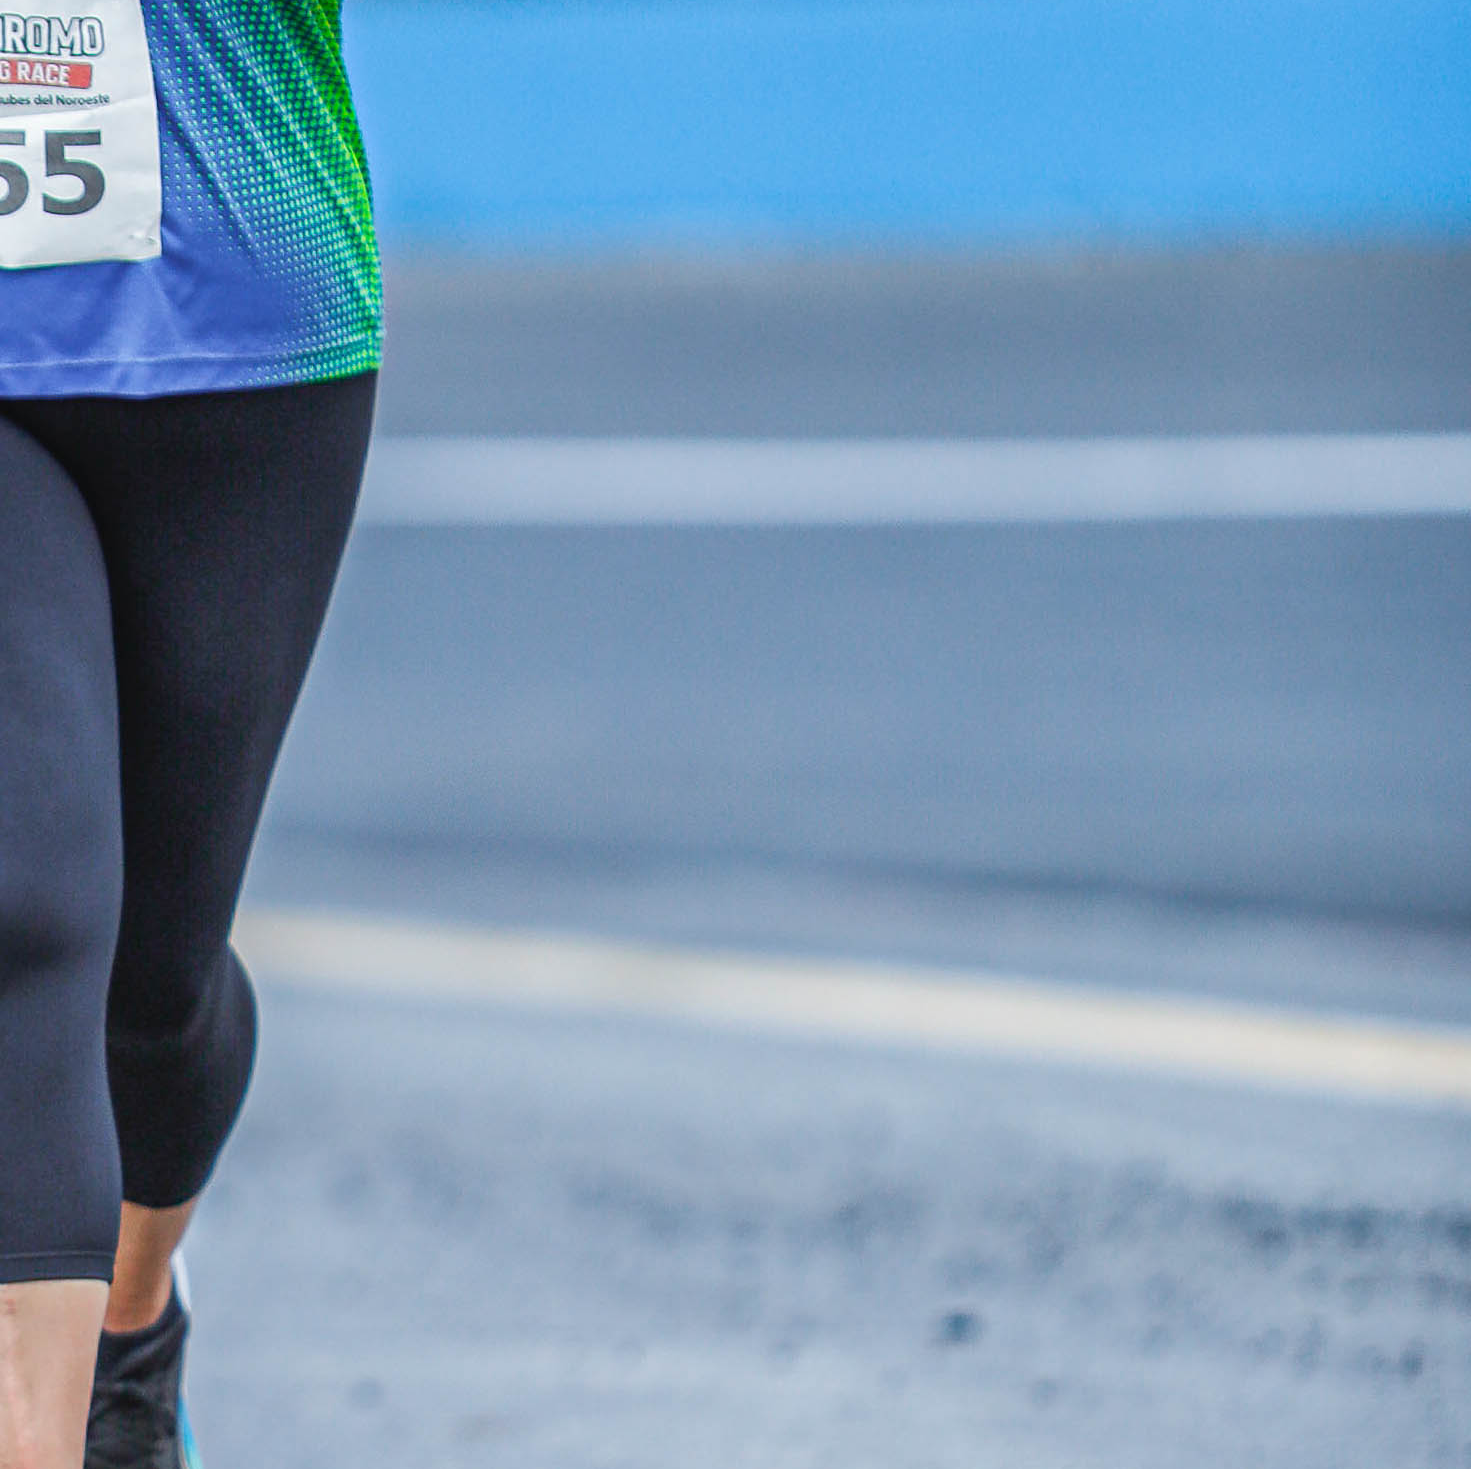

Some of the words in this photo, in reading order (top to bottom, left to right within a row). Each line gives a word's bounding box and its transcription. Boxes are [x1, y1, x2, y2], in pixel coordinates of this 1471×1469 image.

[17, 61, 71, 85] RACE
[33, 93, 54, 106] del
[55, 93, 110, 106] Noroeste
